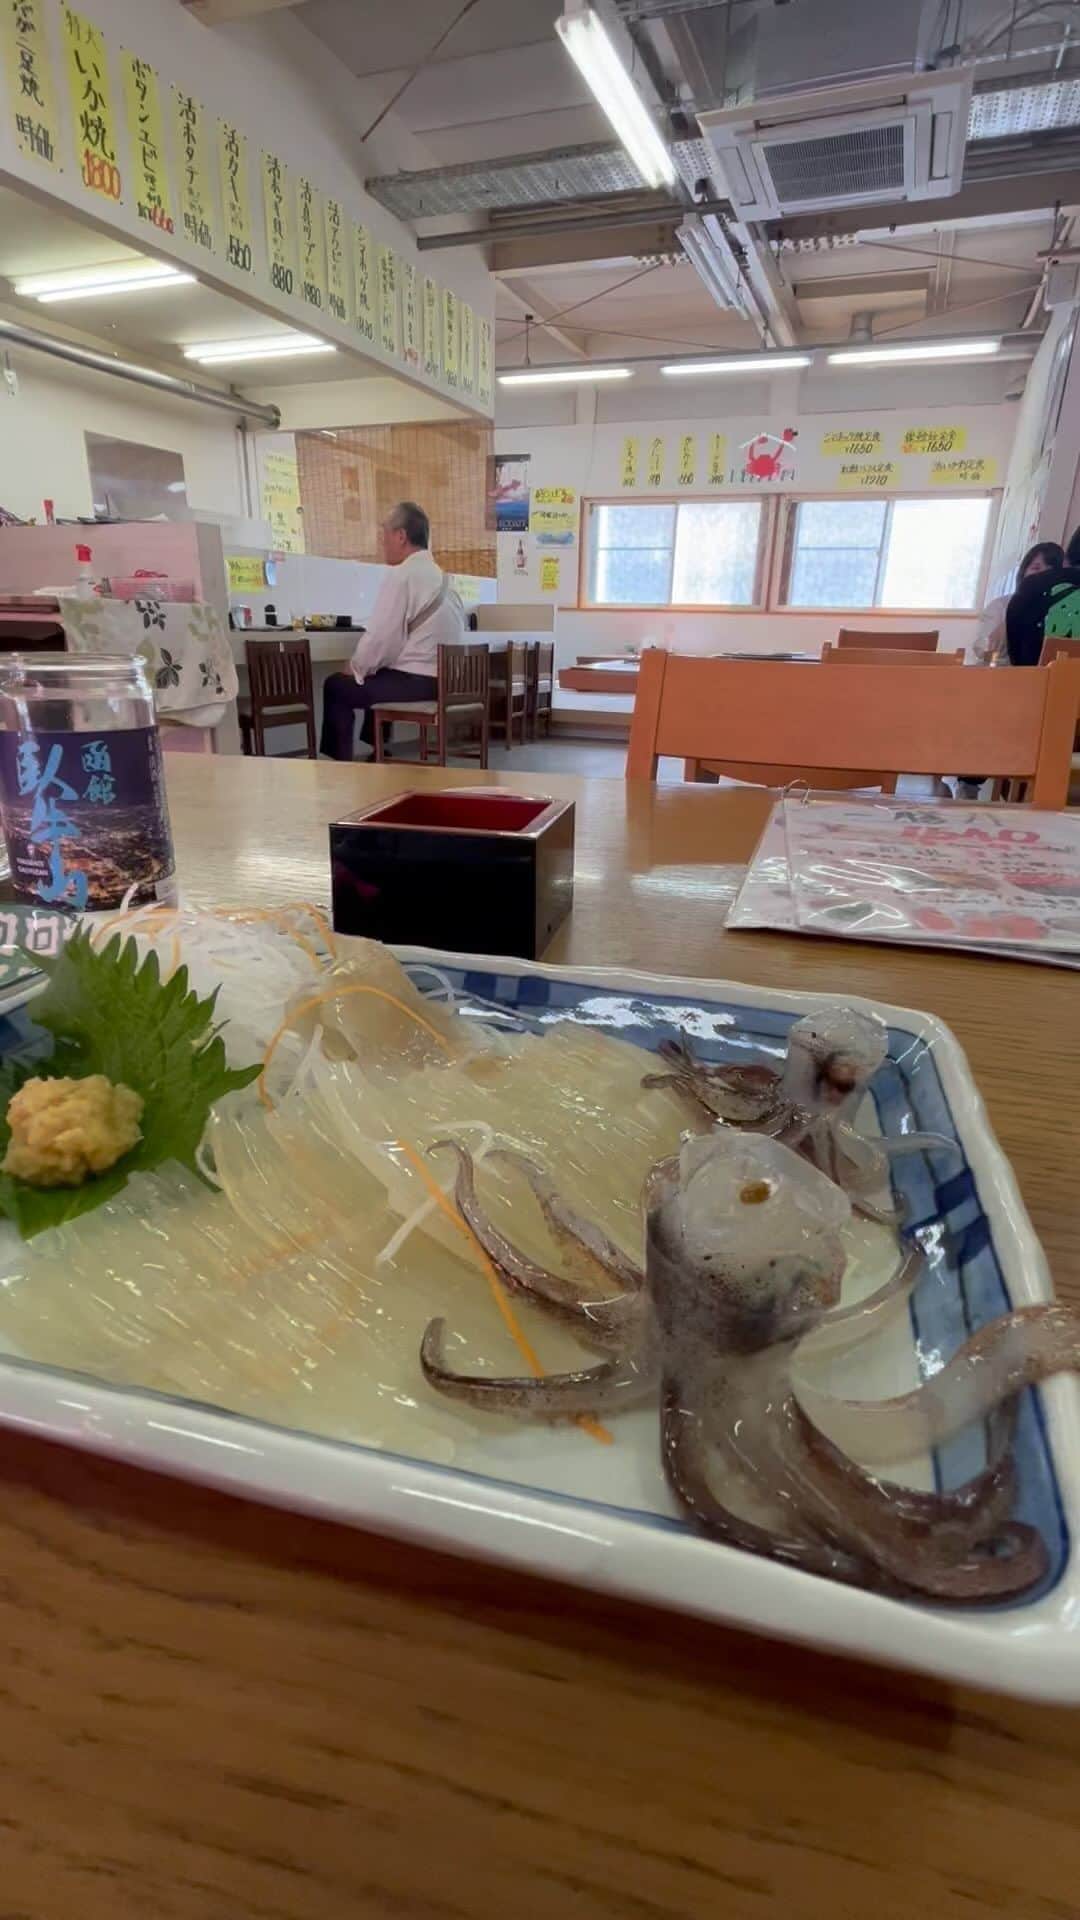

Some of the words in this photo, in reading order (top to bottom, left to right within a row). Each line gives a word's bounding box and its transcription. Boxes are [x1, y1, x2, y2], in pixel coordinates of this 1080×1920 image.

[74, 49, 115, 161] いか焼
[131, 58, 158, 173] ボタンエビ
[178, 92, 202, 185] 活ホタテ
[272, 263, 293, 294] 880
[81, 739, 117, 805] 函館
